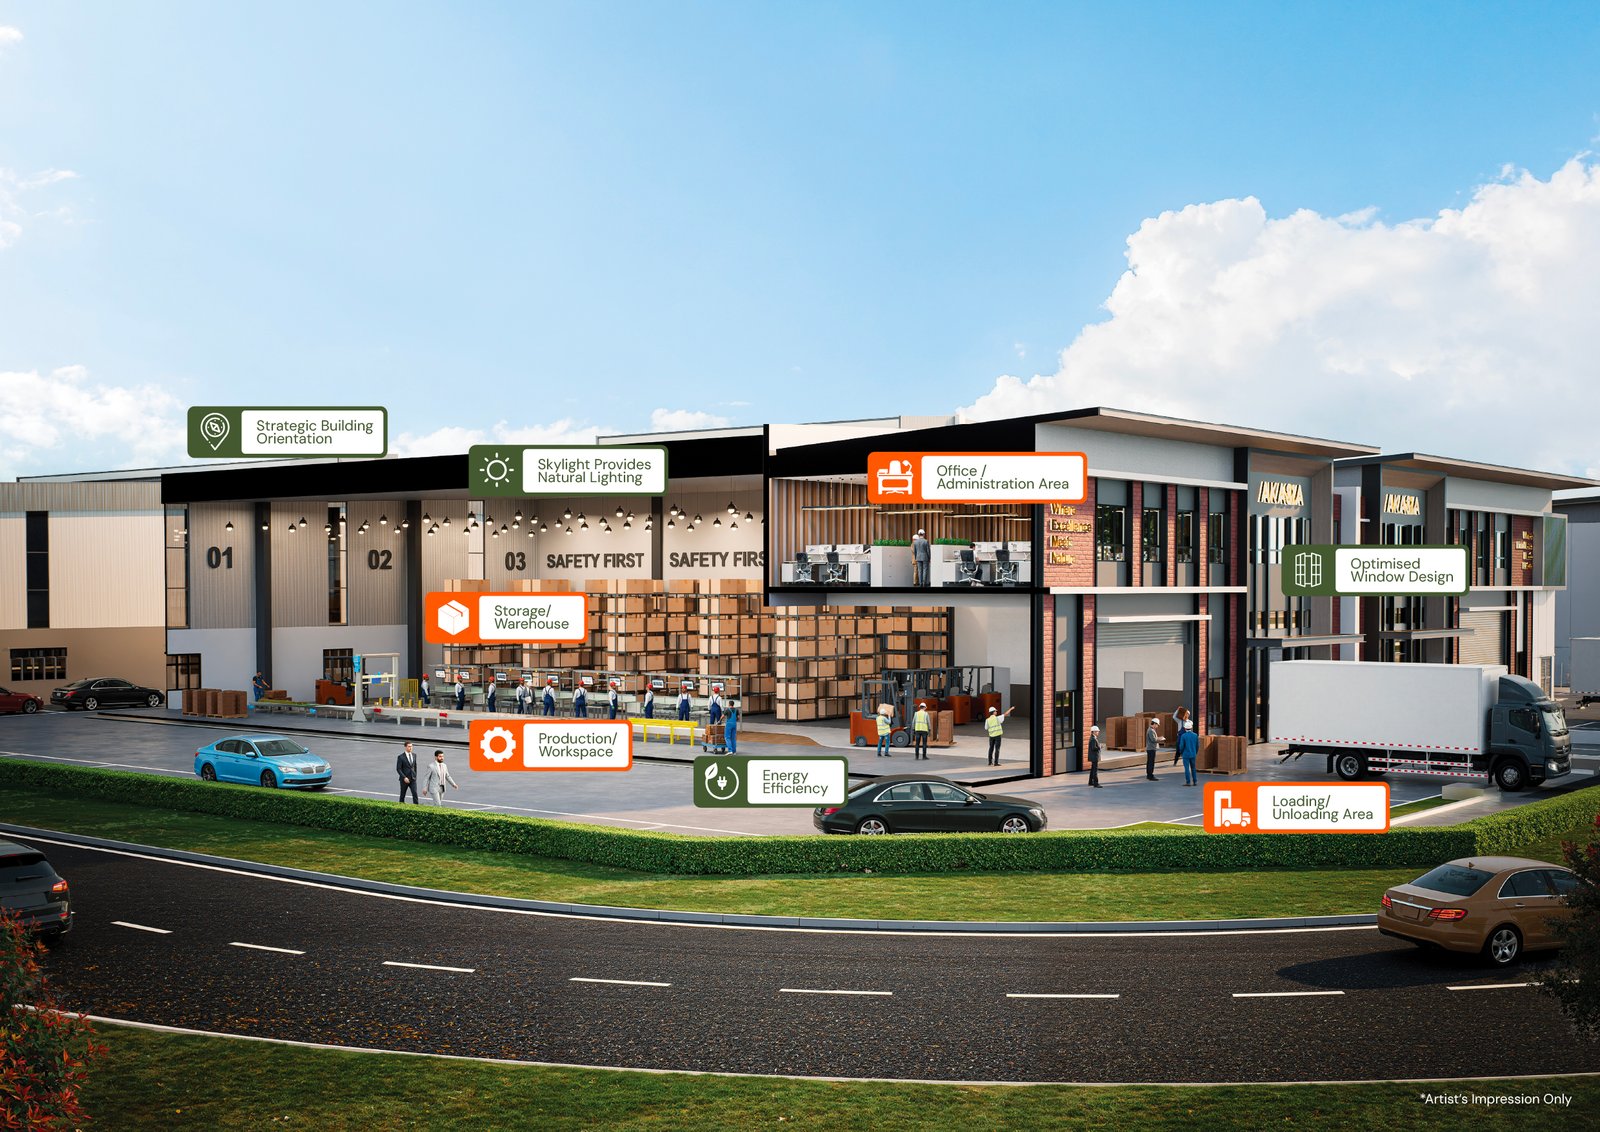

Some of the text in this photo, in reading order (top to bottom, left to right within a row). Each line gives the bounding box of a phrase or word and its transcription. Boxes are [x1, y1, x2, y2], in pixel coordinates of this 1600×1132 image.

[207, 546, 233, 569] 01
[367, 549, 392, 570] 02
[505, 552, 527, 571] 03
[547, 553, 645, 569] SAFETY FIRST
[669, 551, 765, 568] SAFETY FIRS
